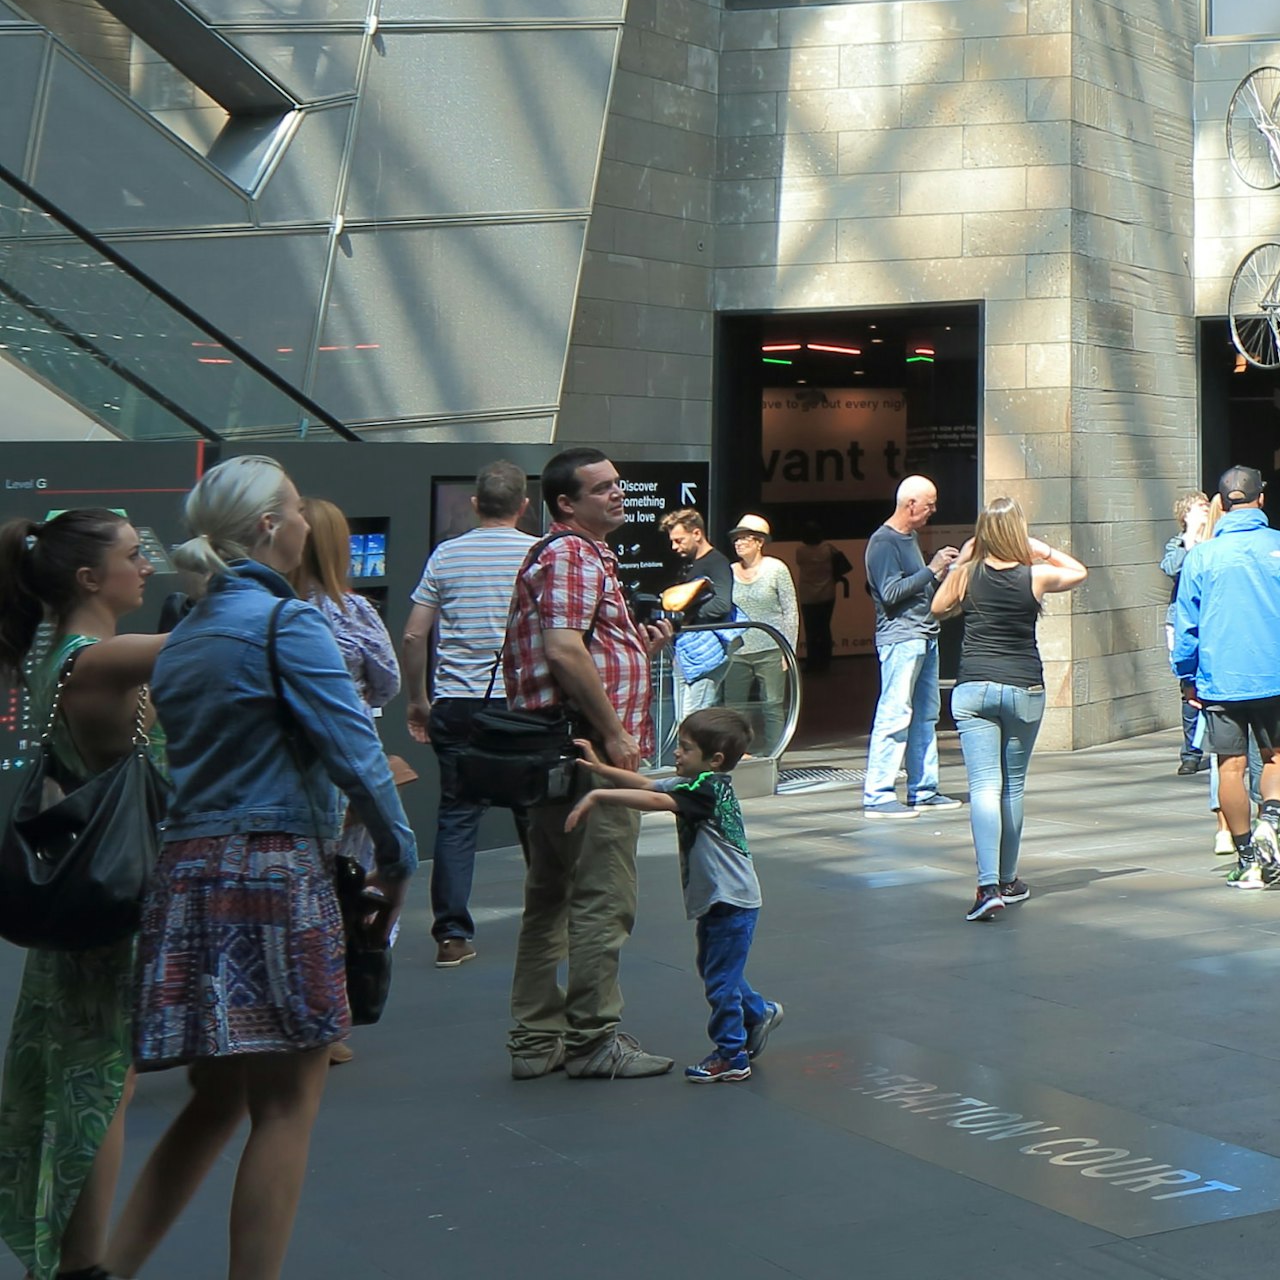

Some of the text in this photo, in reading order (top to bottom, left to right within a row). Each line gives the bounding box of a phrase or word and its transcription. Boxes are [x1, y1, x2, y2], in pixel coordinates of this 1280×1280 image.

[786, 400, 798, 409] to
[822, 399, 841, 409] out
[845, 401, 879, 411] every
[6, 478, 48, 489] Level G
[620, 480, 658, 492] Discover
[624, 511, 655, 523] ou love
[618, 544, 624, 556] 3
[1020, 1137, 1242, 1201] COURT
